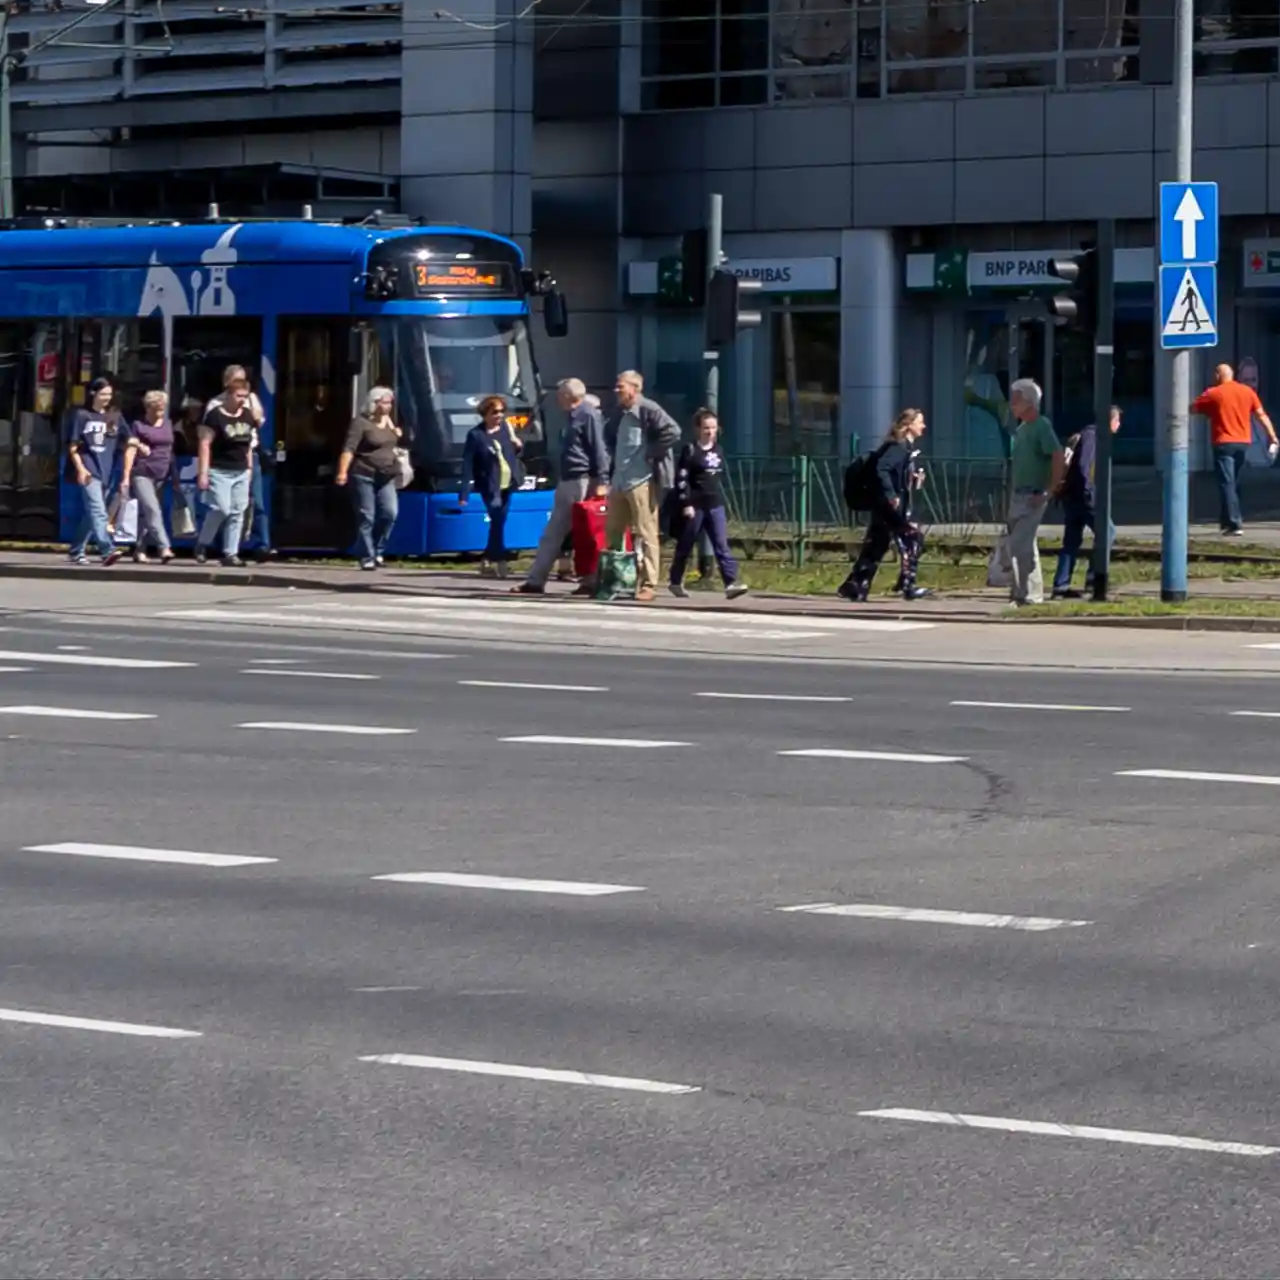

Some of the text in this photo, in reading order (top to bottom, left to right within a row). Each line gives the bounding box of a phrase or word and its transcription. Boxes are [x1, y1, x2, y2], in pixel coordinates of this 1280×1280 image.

[416, 265, 427, 286] 3
[985, 258, 1053, 278] BNP PAR
